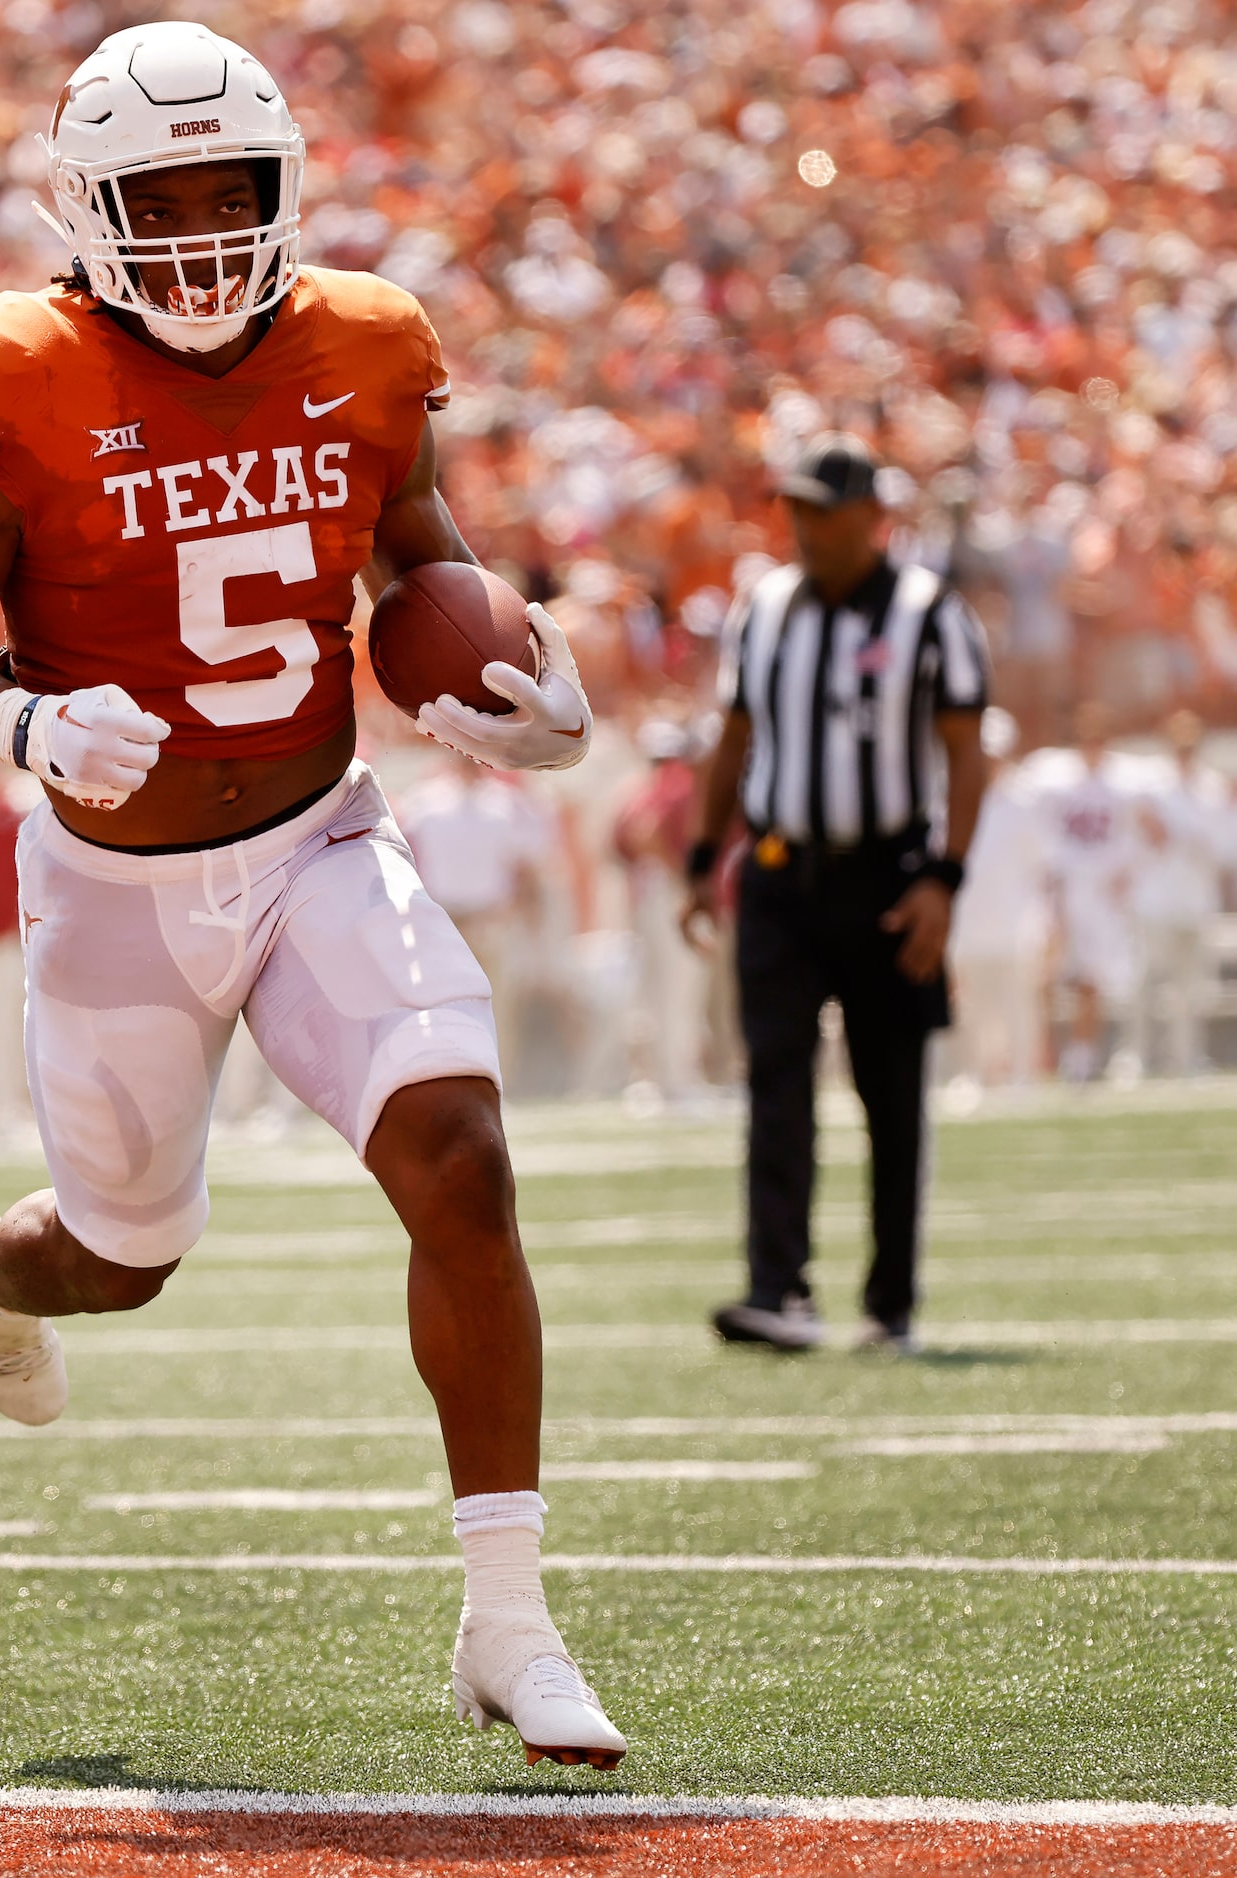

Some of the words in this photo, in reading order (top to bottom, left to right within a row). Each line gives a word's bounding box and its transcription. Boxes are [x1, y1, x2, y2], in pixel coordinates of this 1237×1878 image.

[170, 119, 221, 138] HORNS
[89, 422, 145, 458] XII
[103, 442, 351, 540] TEXAS
[176, 521, 320, 727] 5
